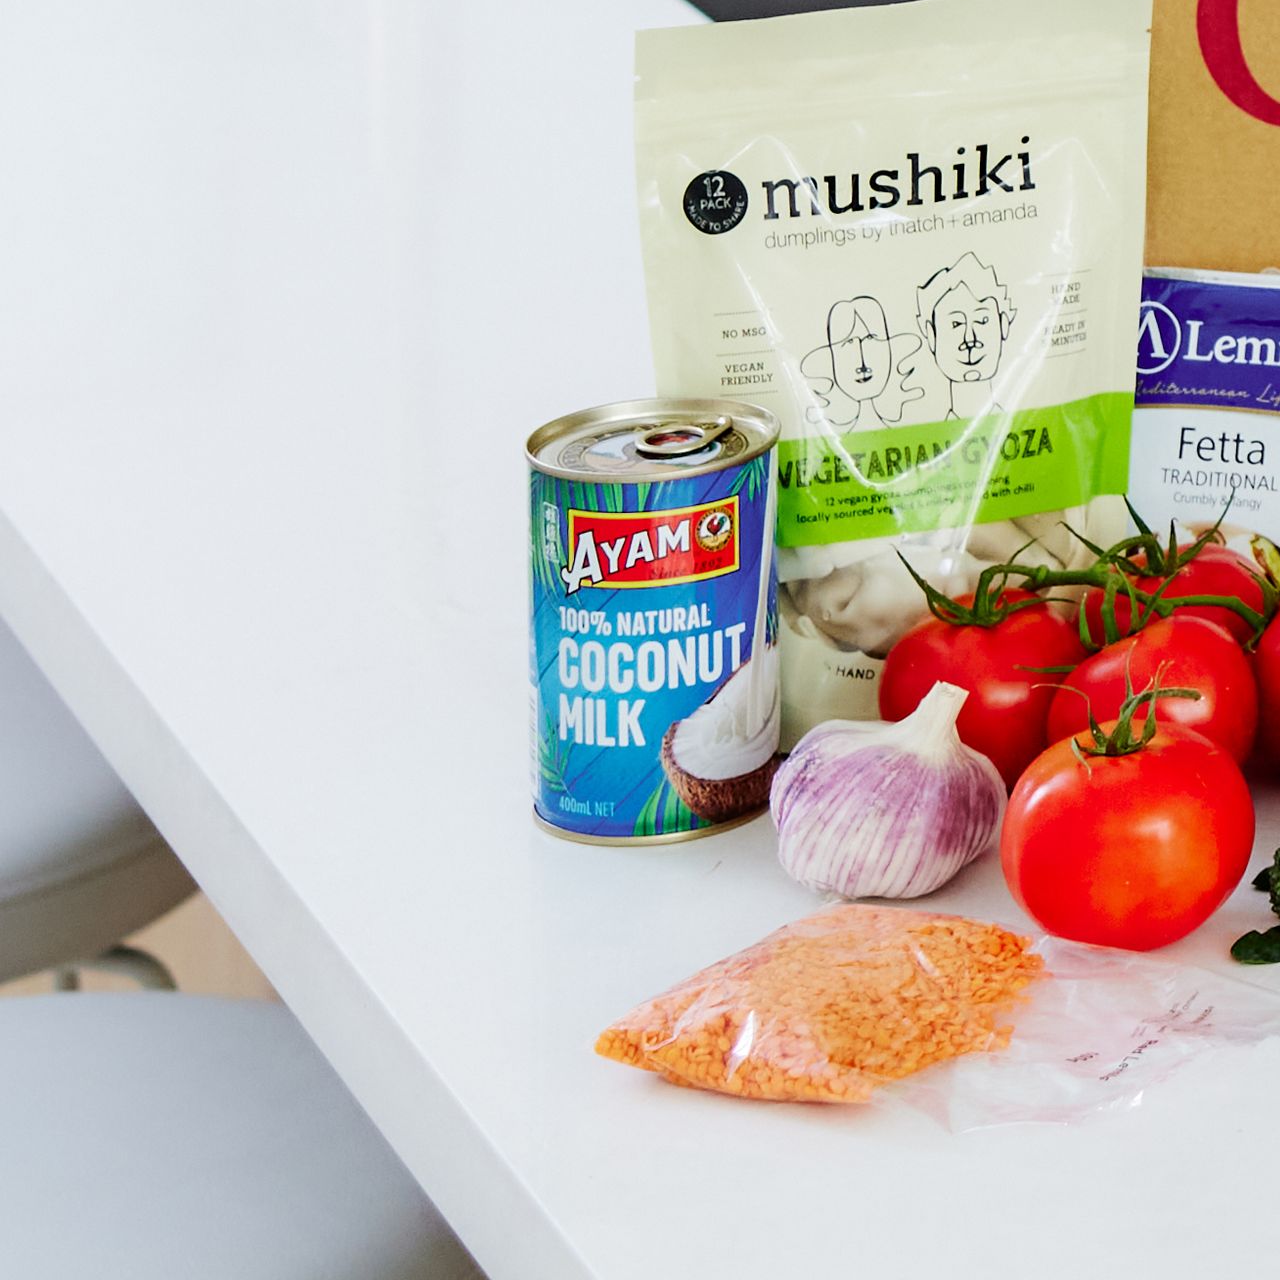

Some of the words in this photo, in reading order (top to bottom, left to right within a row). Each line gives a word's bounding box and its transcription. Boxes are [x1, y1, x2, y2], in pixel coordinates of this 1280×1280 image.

[703, 175, 726, 197] 12
[762, 135, 1036, 221] mushiki
[700, 197, 732, 210] PACK
[764, 228, 856, 250] dumplings
[722, 329, 738, 339] NO
[724, 361, 765, 373] VEGAN
[720, 373, 774, 386] FRIENDLY
[1178, 426, 1266, 466] Fetta
[1161, 467, 1279, 492] TRADITIONAL
[826, 496, 836, 507] 12
[838, 495, 869, 507] vegan
[1173, 491, 1218, 506] Crumbly
[796, 511, 830, 524] locally
[834, 506, 875, 520] sourced
[559, 605, 613, 637] 100%
[616, 602, 712, 637] NATURAL
[559, 622, 747, 694] COCONUT
[836, 665, 876, 680] HAND
[559, 693, 647, 748] MILK
[559, 796, 594, 816] 400mL
[595, 801, 615, 818] NET
